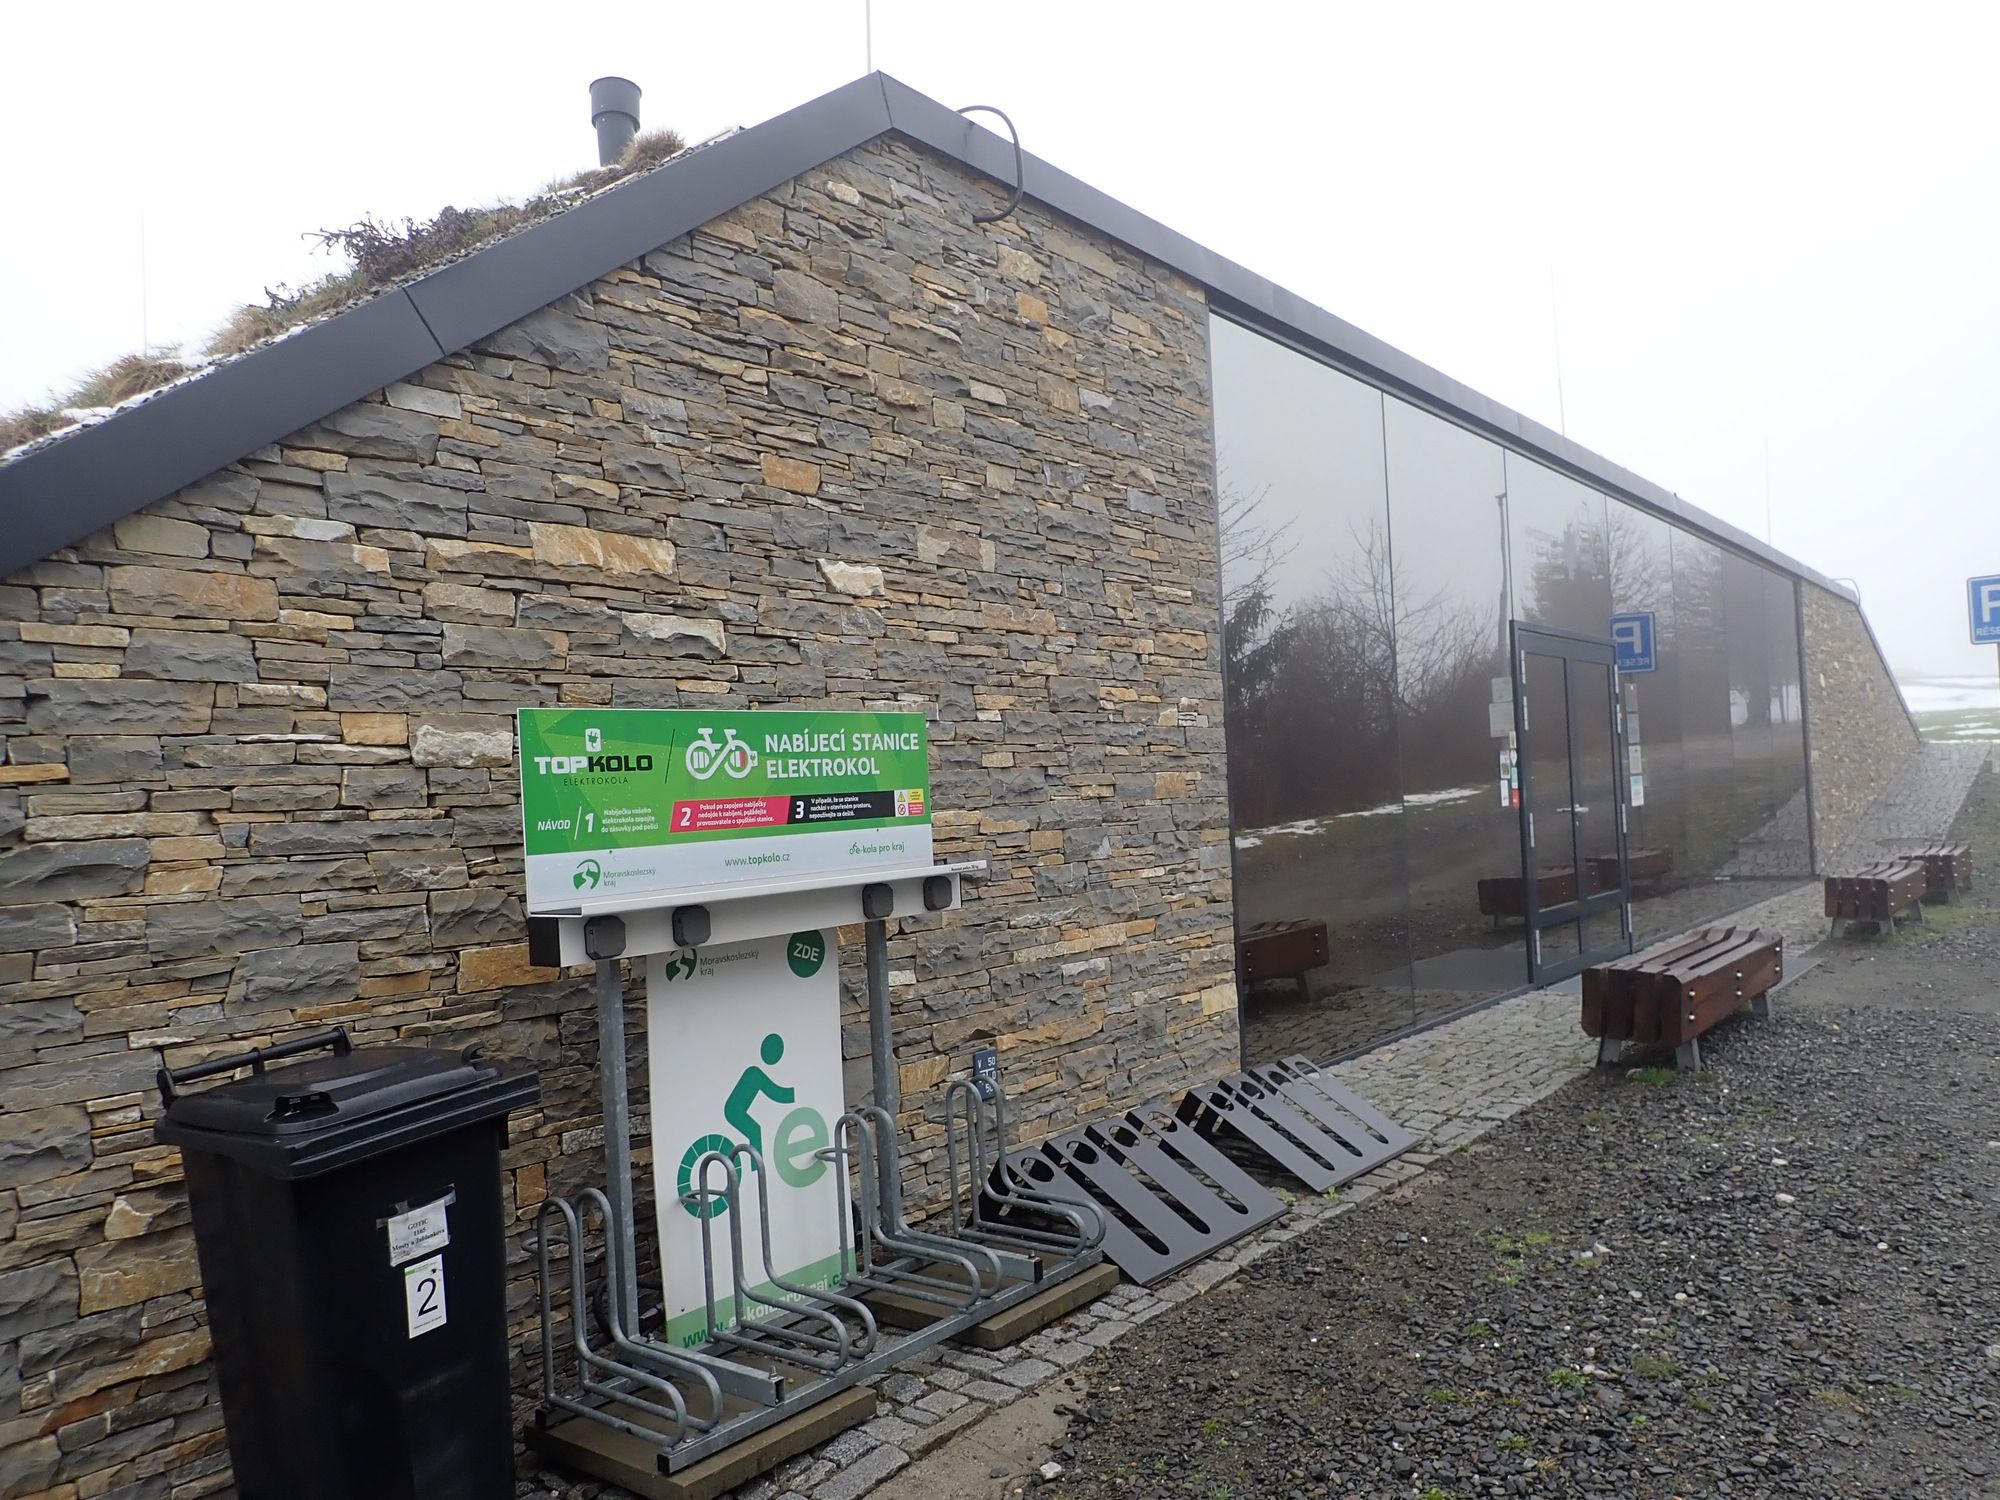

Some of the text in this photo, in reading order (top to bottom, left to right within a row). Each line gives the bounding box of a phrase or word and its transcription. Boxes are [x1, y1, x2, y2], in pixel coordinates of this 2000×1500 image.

[765, 728, 919, 753] NABÍJECÍ STANICE
[533, 754, 653, 775] TOPKOLO
[766, 757, 880, 778] ELEKTROKOL
[564, 777, 629, 786] ELEKTROKOLA
[680, 807, 691, 826] 2
[795, 801, 804, 819] 3
[537, 819, 571, 831] NÁVOD
[585, 812, 595, 832] 1
[879, 845, 891, 854] pro
[892, 841, 905, 853] kraj
[724, 852, 791, 867] www.topkolo.cz
[603, 867, 656, 879] Moravskoslezský
[603, 879, 616, 888] kraj
[700, 950, 759, 966] Moravskoslezský
[793, 943, 819, 962] ZDE
[700, 967, 714, 977] kraj
[417, 1278, 439, 1317] 2
